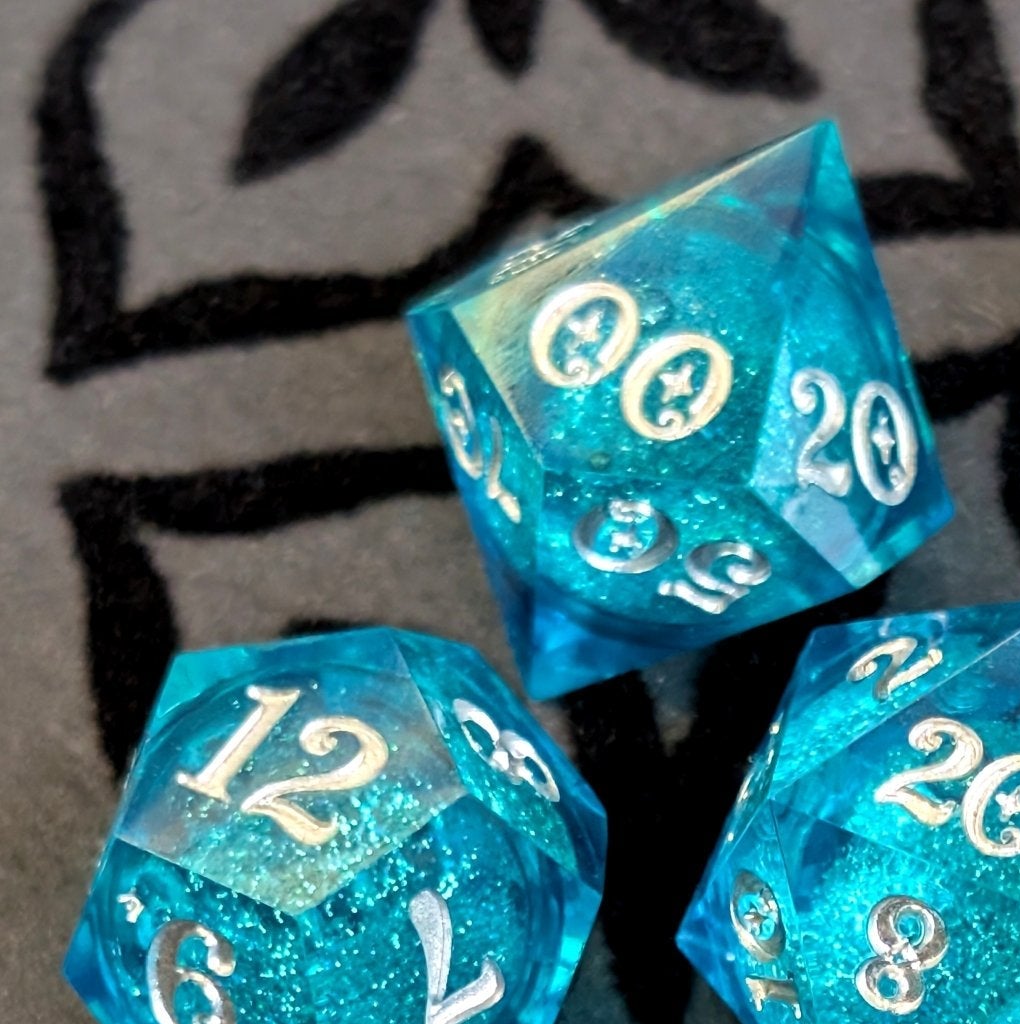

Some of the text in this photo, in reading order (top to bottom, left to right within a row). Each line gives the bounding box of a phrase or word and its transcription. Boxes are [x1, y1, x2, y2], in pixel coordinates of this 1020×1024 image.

[529, 281, 733, 442] 00
[790, 368, 918, 506] 20
[846, 636, 944, 702] 2
[177, 684, 390, 846] 12
[452, 698, 561, 803] 8
[855, 894, 950, 1016] 8
